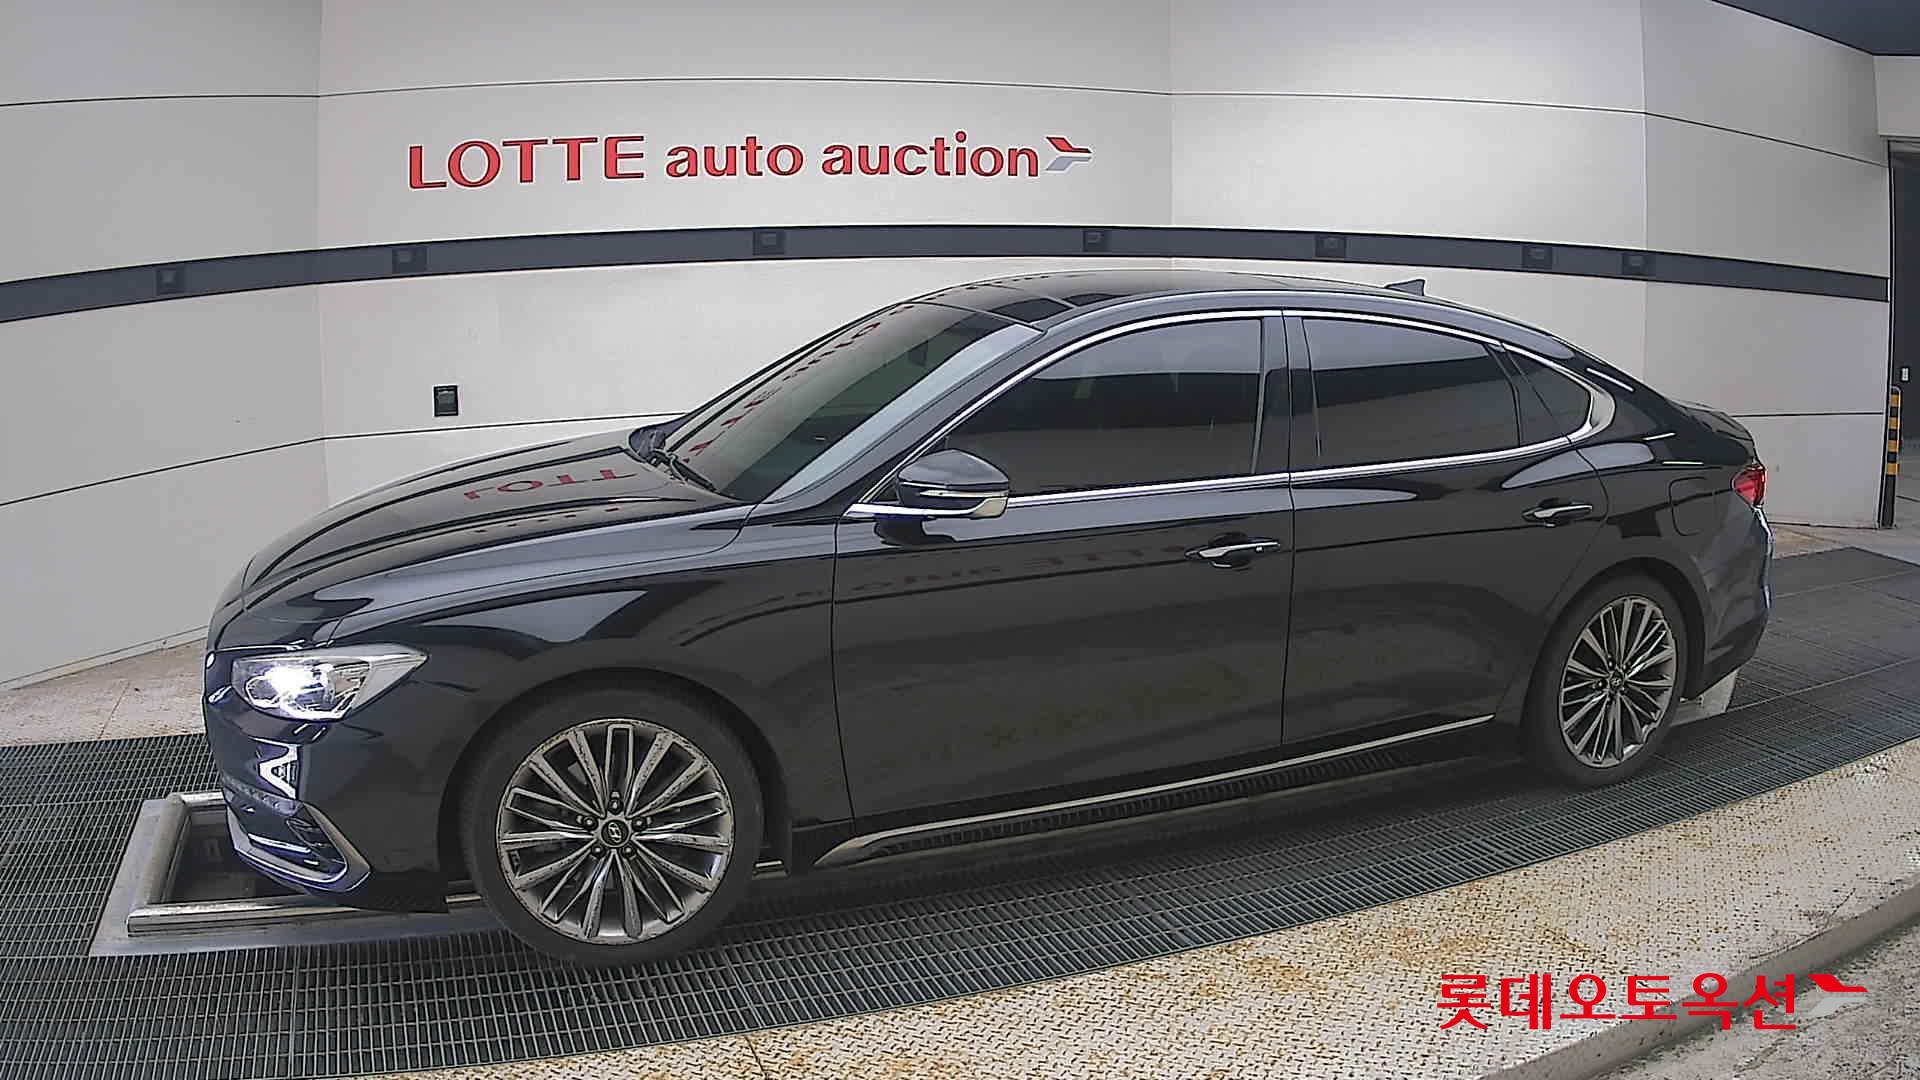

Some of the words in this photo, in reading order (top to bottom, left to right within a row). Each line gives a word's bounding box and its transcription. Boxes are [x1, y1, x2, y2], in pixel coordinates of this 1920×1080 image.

[408, 135, 645, 189] LOTTE
[665, 135, 804, 177] auto
[821, 131, 1040, 178] auction
